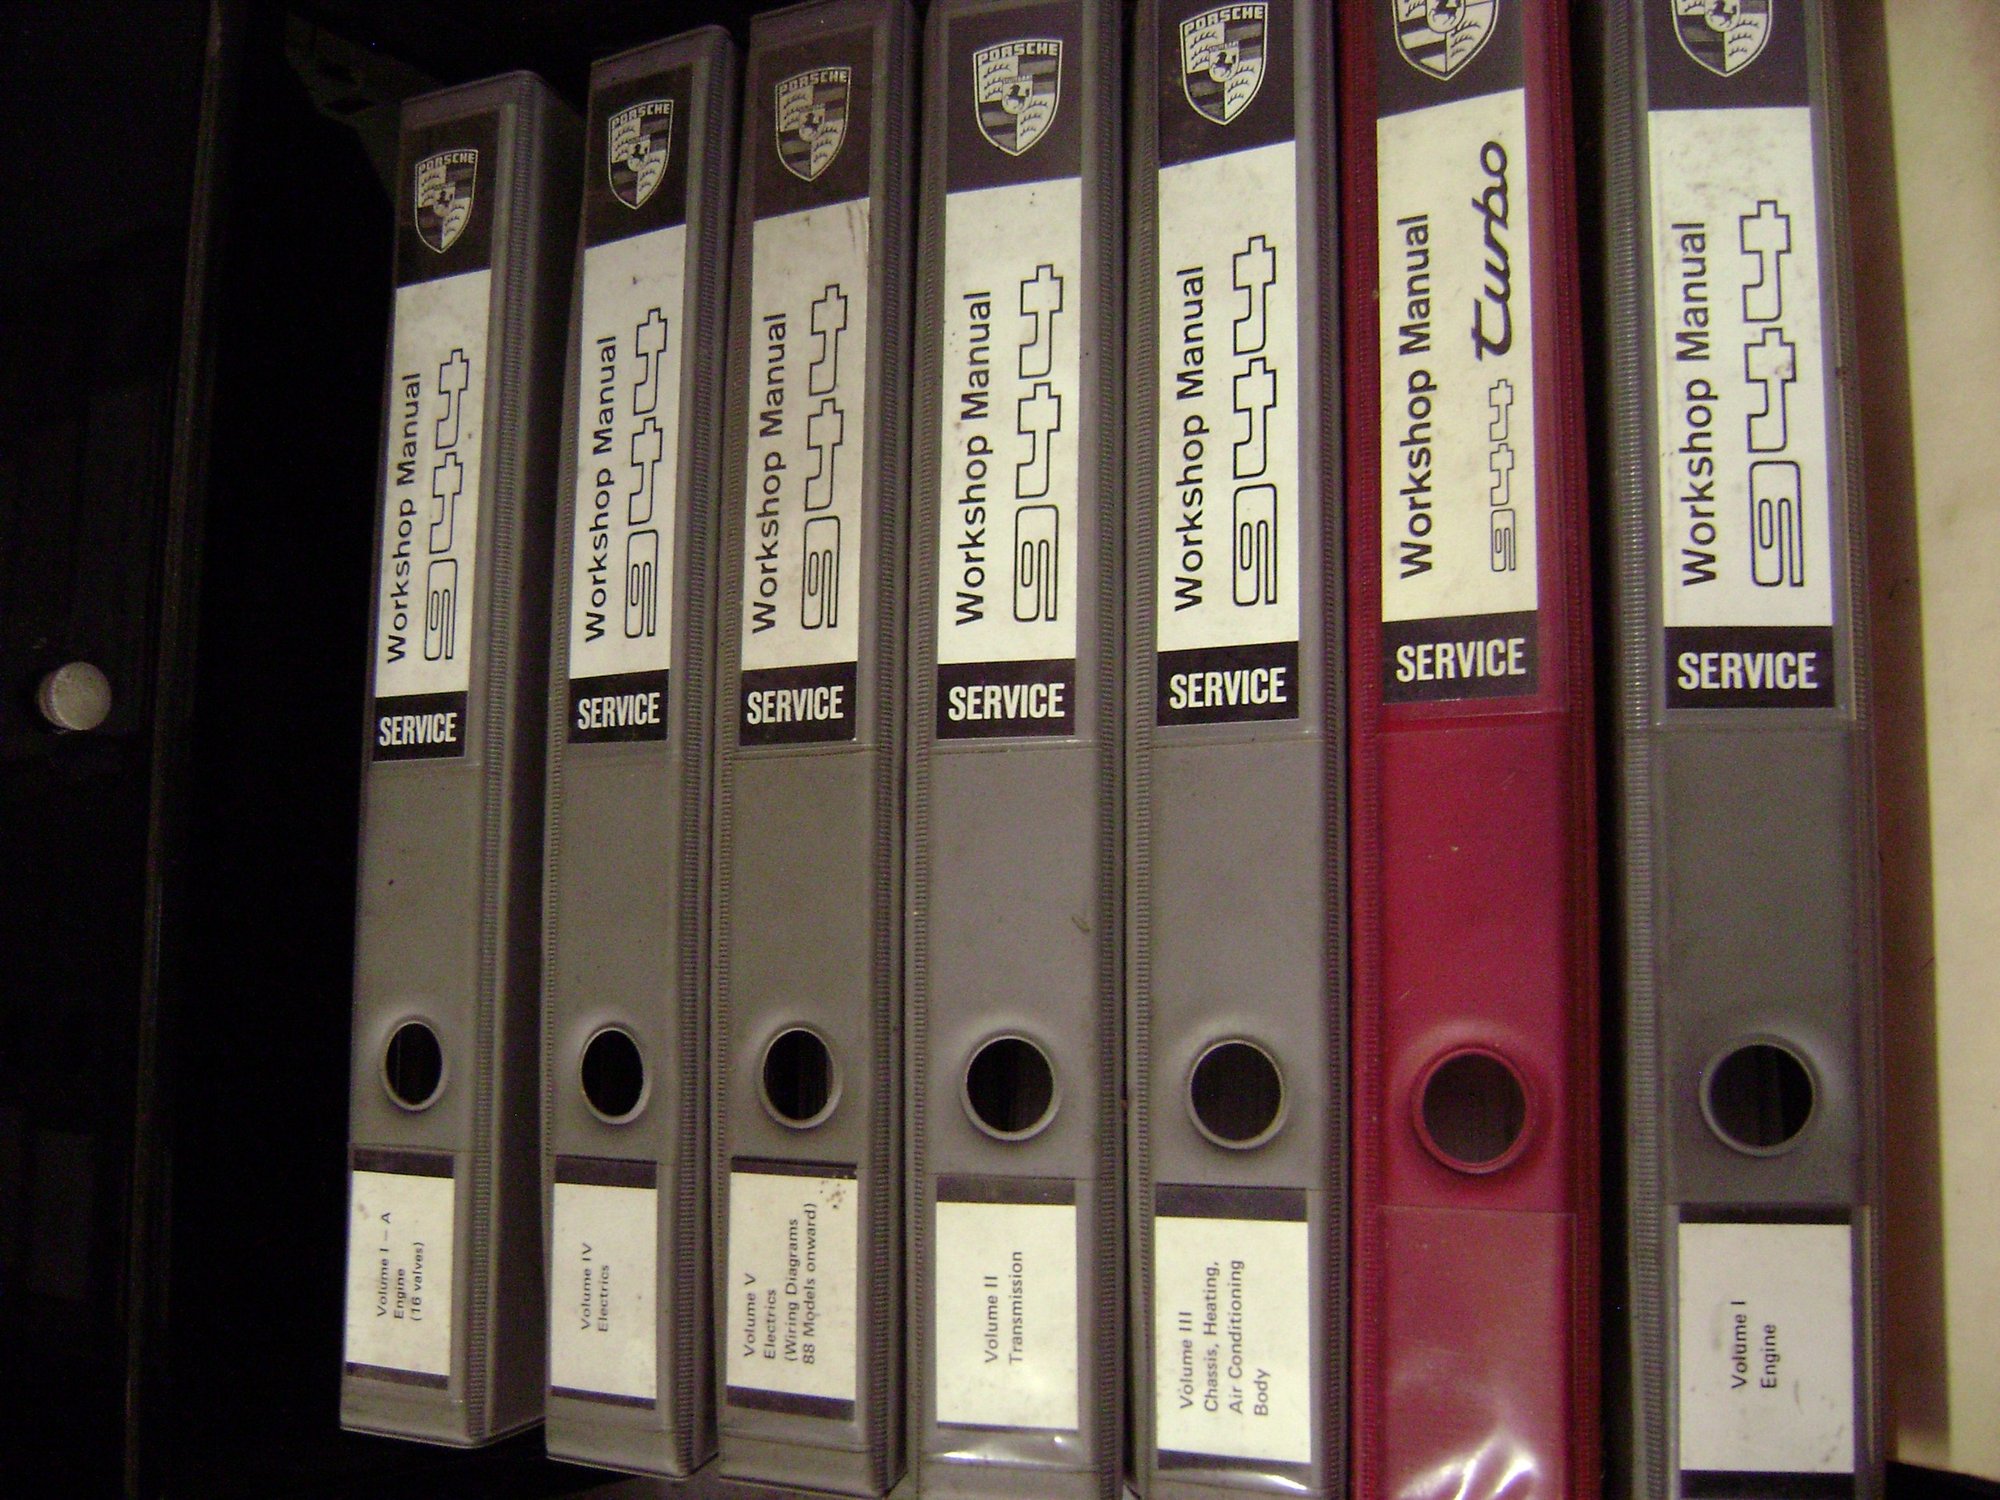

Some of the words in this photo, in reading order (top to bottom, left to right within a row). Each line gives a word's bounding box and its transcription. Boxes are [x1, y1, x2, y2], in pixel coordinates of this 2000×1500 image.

[978, 42, 1059, 64] PORSCHE
[1184, 6, 1264, 35] PORSCHE
[612, 103, 670, 127] PORSCHE
[780, 71, 847, 95] PORSCHE
[419, 152, 475, 173] PORSCHE
[1397, 214, 1430, 355] Manual
[1471, 140, 1514, 363] turbo
[1671, 221, 1706, 362] Manual
[960, 291, 991, 421] Manual
[1176, 266, 1204, 400] Manual
[593, 335, 617, 455] Manual
[759, 312, 787, 438] Manual
[1739, 200, 1804, 588] 944
[396, 372, 421, 485] Manual
[1013, 264, 1064, 623] 944
[1232, 234, 1278, 607] 944
[624, 308, 667, 639] 944
[801, 283, 848, 630] 944
[1400, 369, 1438, 580] Workshop
[1488, 378, 1517, 573] 944
[1678, 378, 1718, 588] Workshop
[424, 348, 469, 661] 944
[955, 436, 994, 626] Workshop
[1175, 414, 1210, 612] Workshop
[584, 467, 614, 643] Workshop
[752, 450, 787, 635] Workshop
[387, 498, 417, 664] Workshop
[1169, 667, 1286, 710] SERVICE
[1396, 638, 1526, 682] SERVICE
[1677, 651, 1818, 690] SERVICE
[379, 712, 457, 747] SERVICE
[577, 692, 660, 730] SERVICE
[746, 685, 844, 725] SERVICE
[948, 683, 1065, 721] SERVICE
[381, 1212, 391, 1224] A
[582, 1243, 592, 1261] IV
[804, 1202, 817, 1272] onward)
[377, 1258, 390, 1316] Volume
[413, 1241, 425, 1291] valves)
[744, 1273, 756, 1285] V
[786, 1218, 800, 1295] Diagrams
[984, 1276, 998, 1288] II
[394, 1268, 407, 1319] Engine
[411, 1296, 422, 1321] (16
[581, 1268, 592, 1330] Volume
[598, 1265, 609, 1332] Electrics
[744, 1293, 756, 1357] Volume
[764, 1289, 776, 1359] Electrics
[803, 1278, 816, 1336] Models
[1009, 1251, 1023, 1365] Transmission
[1179, 1311, 1192, 1331] III
[1203, 1261, 1220, 1336] Heating,
[1227, 1260, 1245, 1379] Conditioning
[784, 1302, 799, 1361] (Wiring
[803, 1343, 815, 1364] 88
[985, 1295, 998, 1364] Volume
[1731, 1314, 1747, 1389] Volume
[1760, 1324, 1780, 1389] Engine
[1180, 1340, 1193, 1409] Volume
[1203, 1343, 1220, 1412] Chassis,
[1228, 1386, 1243, 1414] Air
[1254, 1368, 1270, 1416] Body
